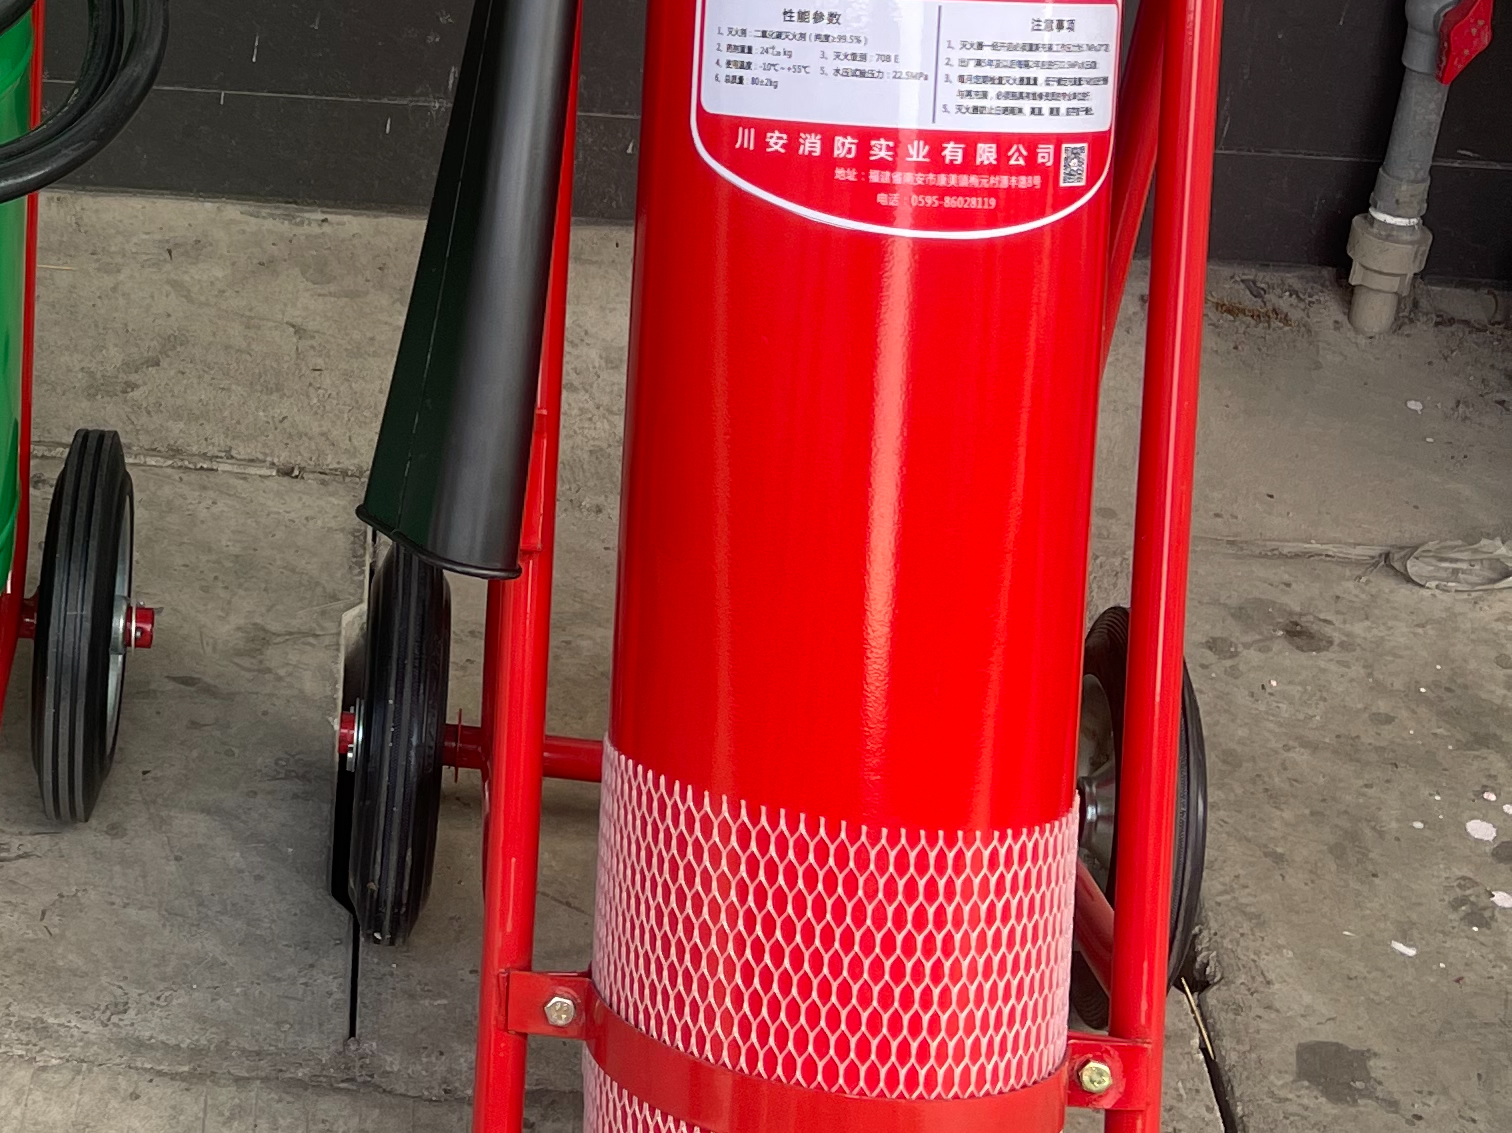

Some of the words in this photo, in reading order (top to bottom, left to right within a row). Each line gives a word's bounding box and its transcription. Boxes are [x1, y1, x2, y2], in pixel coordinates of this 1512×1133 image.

[735, 126, 1055, 167] 川安消防实业有限公司
